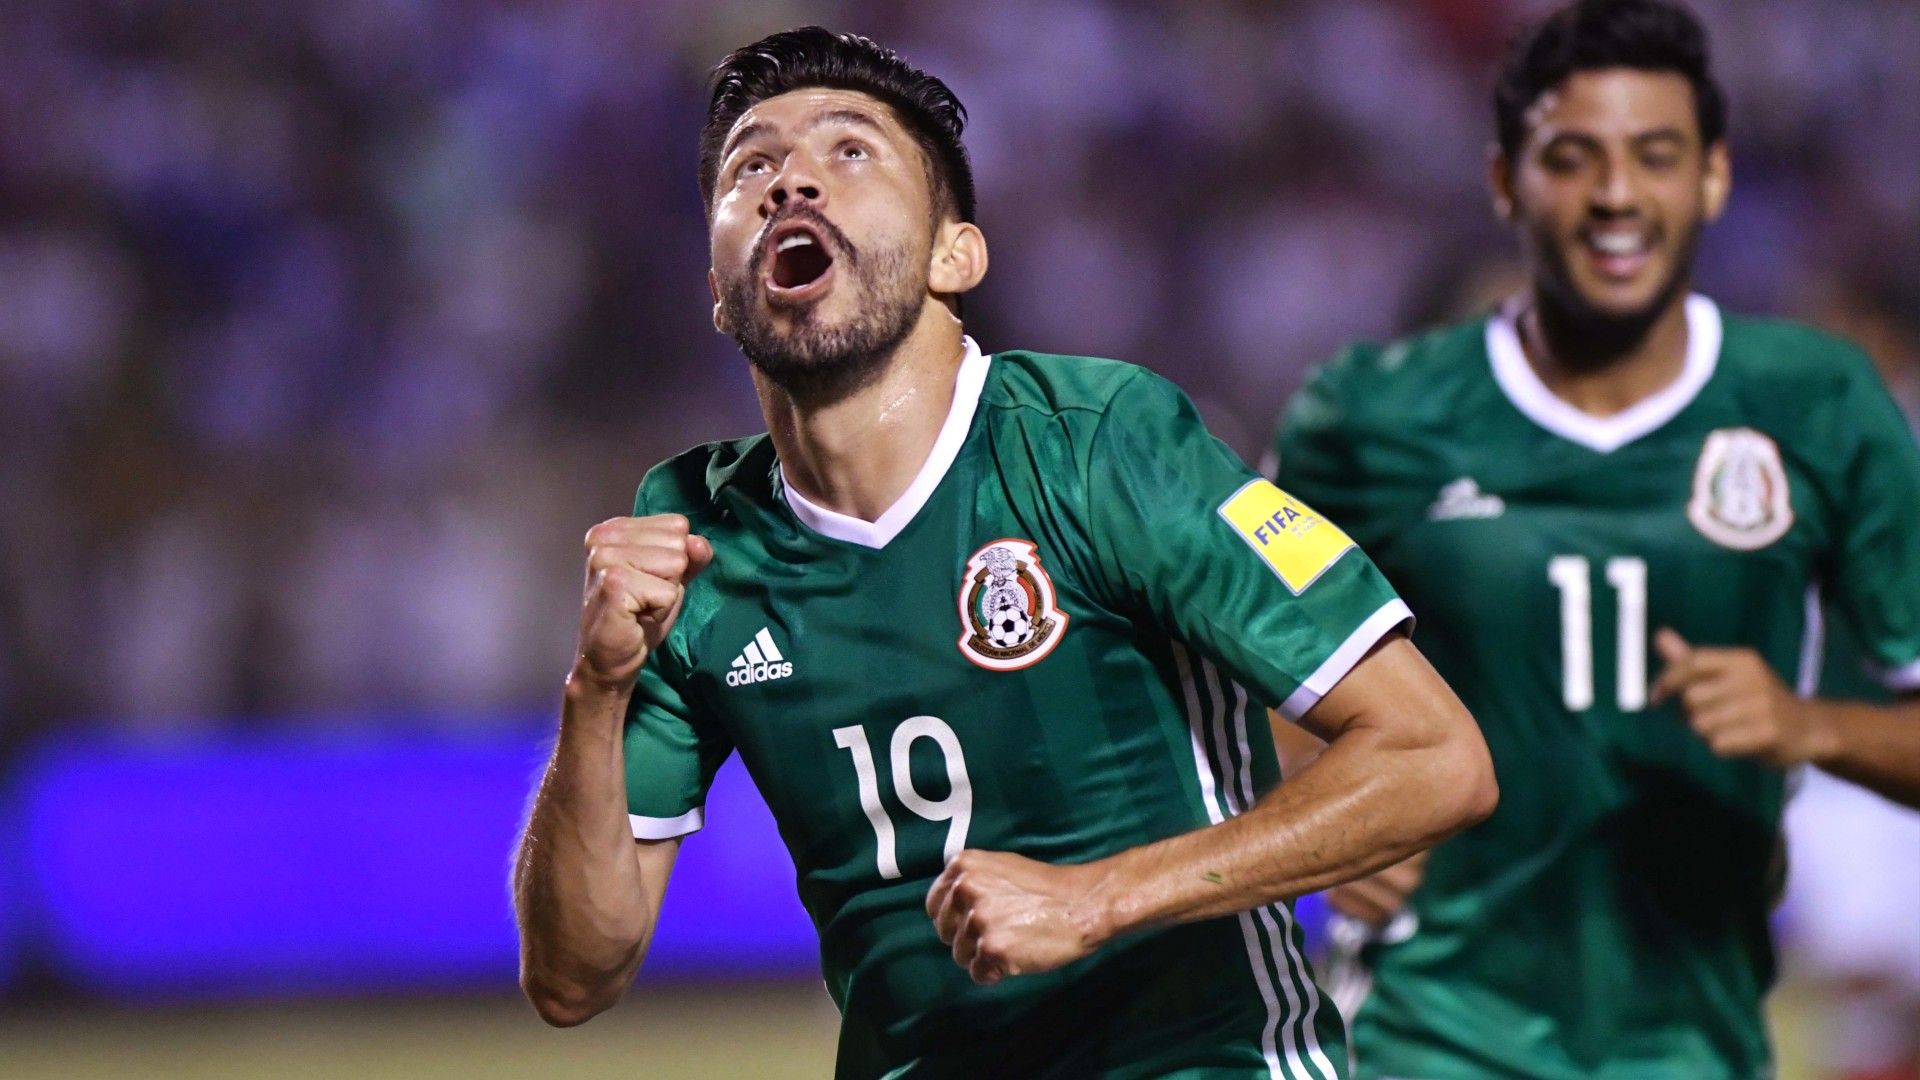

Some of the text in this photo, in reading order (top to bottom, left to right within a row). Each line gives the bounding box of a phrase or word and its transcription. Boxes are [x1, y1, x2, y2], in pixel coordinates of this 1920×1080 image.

[1254, 506, 1301, 546] FIFA
[725, 661, 793, 687] adidas
[1547, 554, 1648, 712] 11
[832, 715, 973, 880] 19
